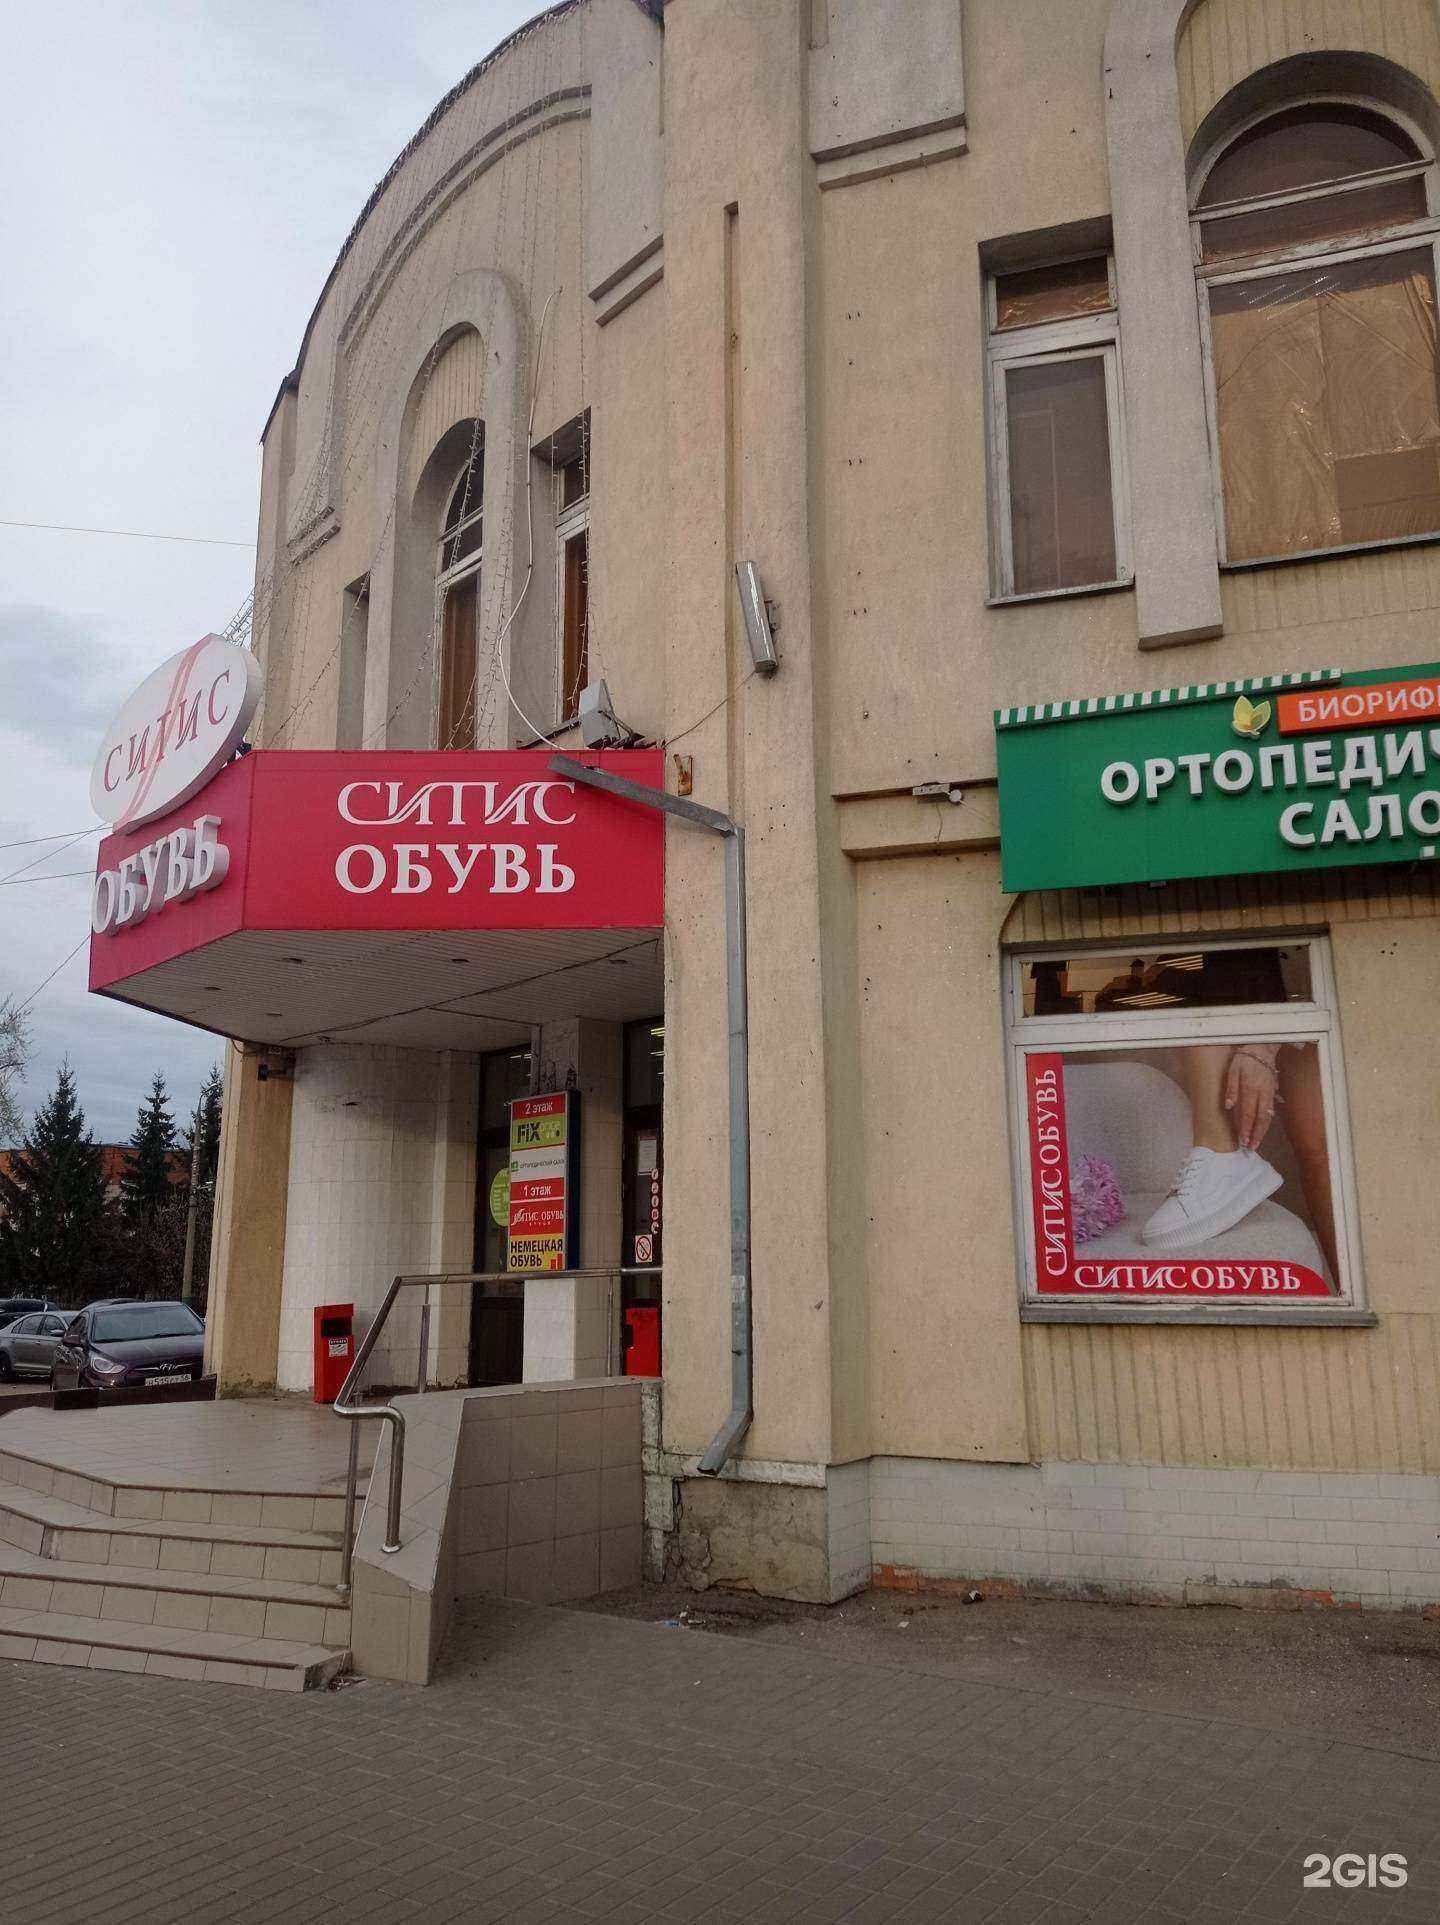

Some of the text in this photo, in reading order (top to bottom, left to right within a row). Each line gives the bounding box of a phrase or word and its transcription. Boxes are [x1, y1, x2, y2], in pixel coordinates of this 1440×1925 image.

[1298, 685, 1440, 723] БИОРИФ
[337, 781, 577, 825] СИТИС
[92, 815, 228, 937] ОБУВЬ
[335, 844, 576, 894] ОБУВЬ
[525, 1101, 553, 1114] 2 этаж
[517, 1122, 540, 1143] FIX
[523, 1185, 552, 1197] 1 этаж
[510, 1239, 563, 1254] НЕМЕЦКАЯ
[510, 1254, 542, 1268] ОБУВЬ
